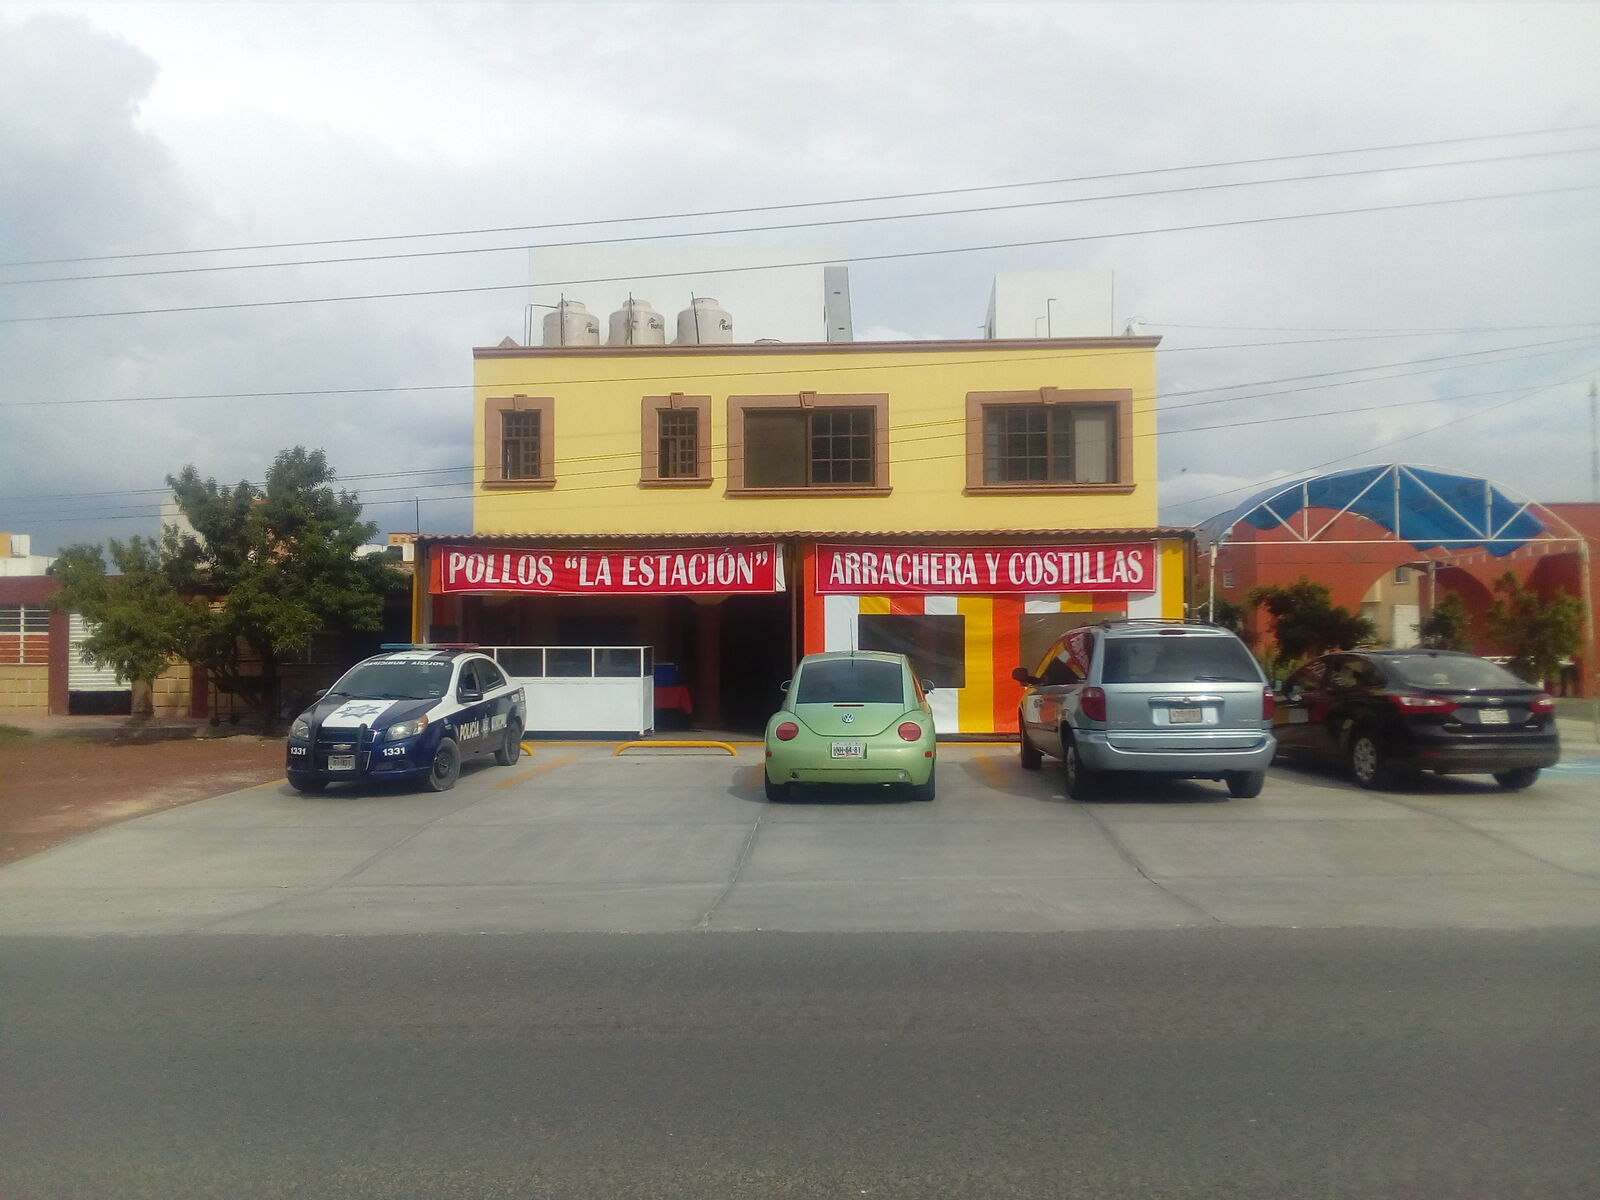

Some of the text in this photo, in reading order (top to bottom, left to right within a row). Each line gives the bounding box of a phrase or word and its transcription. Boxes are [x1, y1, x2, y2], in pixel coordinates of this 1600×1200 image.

[449, 552, 553, 586] POLLOS
[829, 550, 1144, 585] ARRACHERA Y COSTILLAS
[290, 747, 306, 755] 1331
[382, 747, 406, 756] 1331
